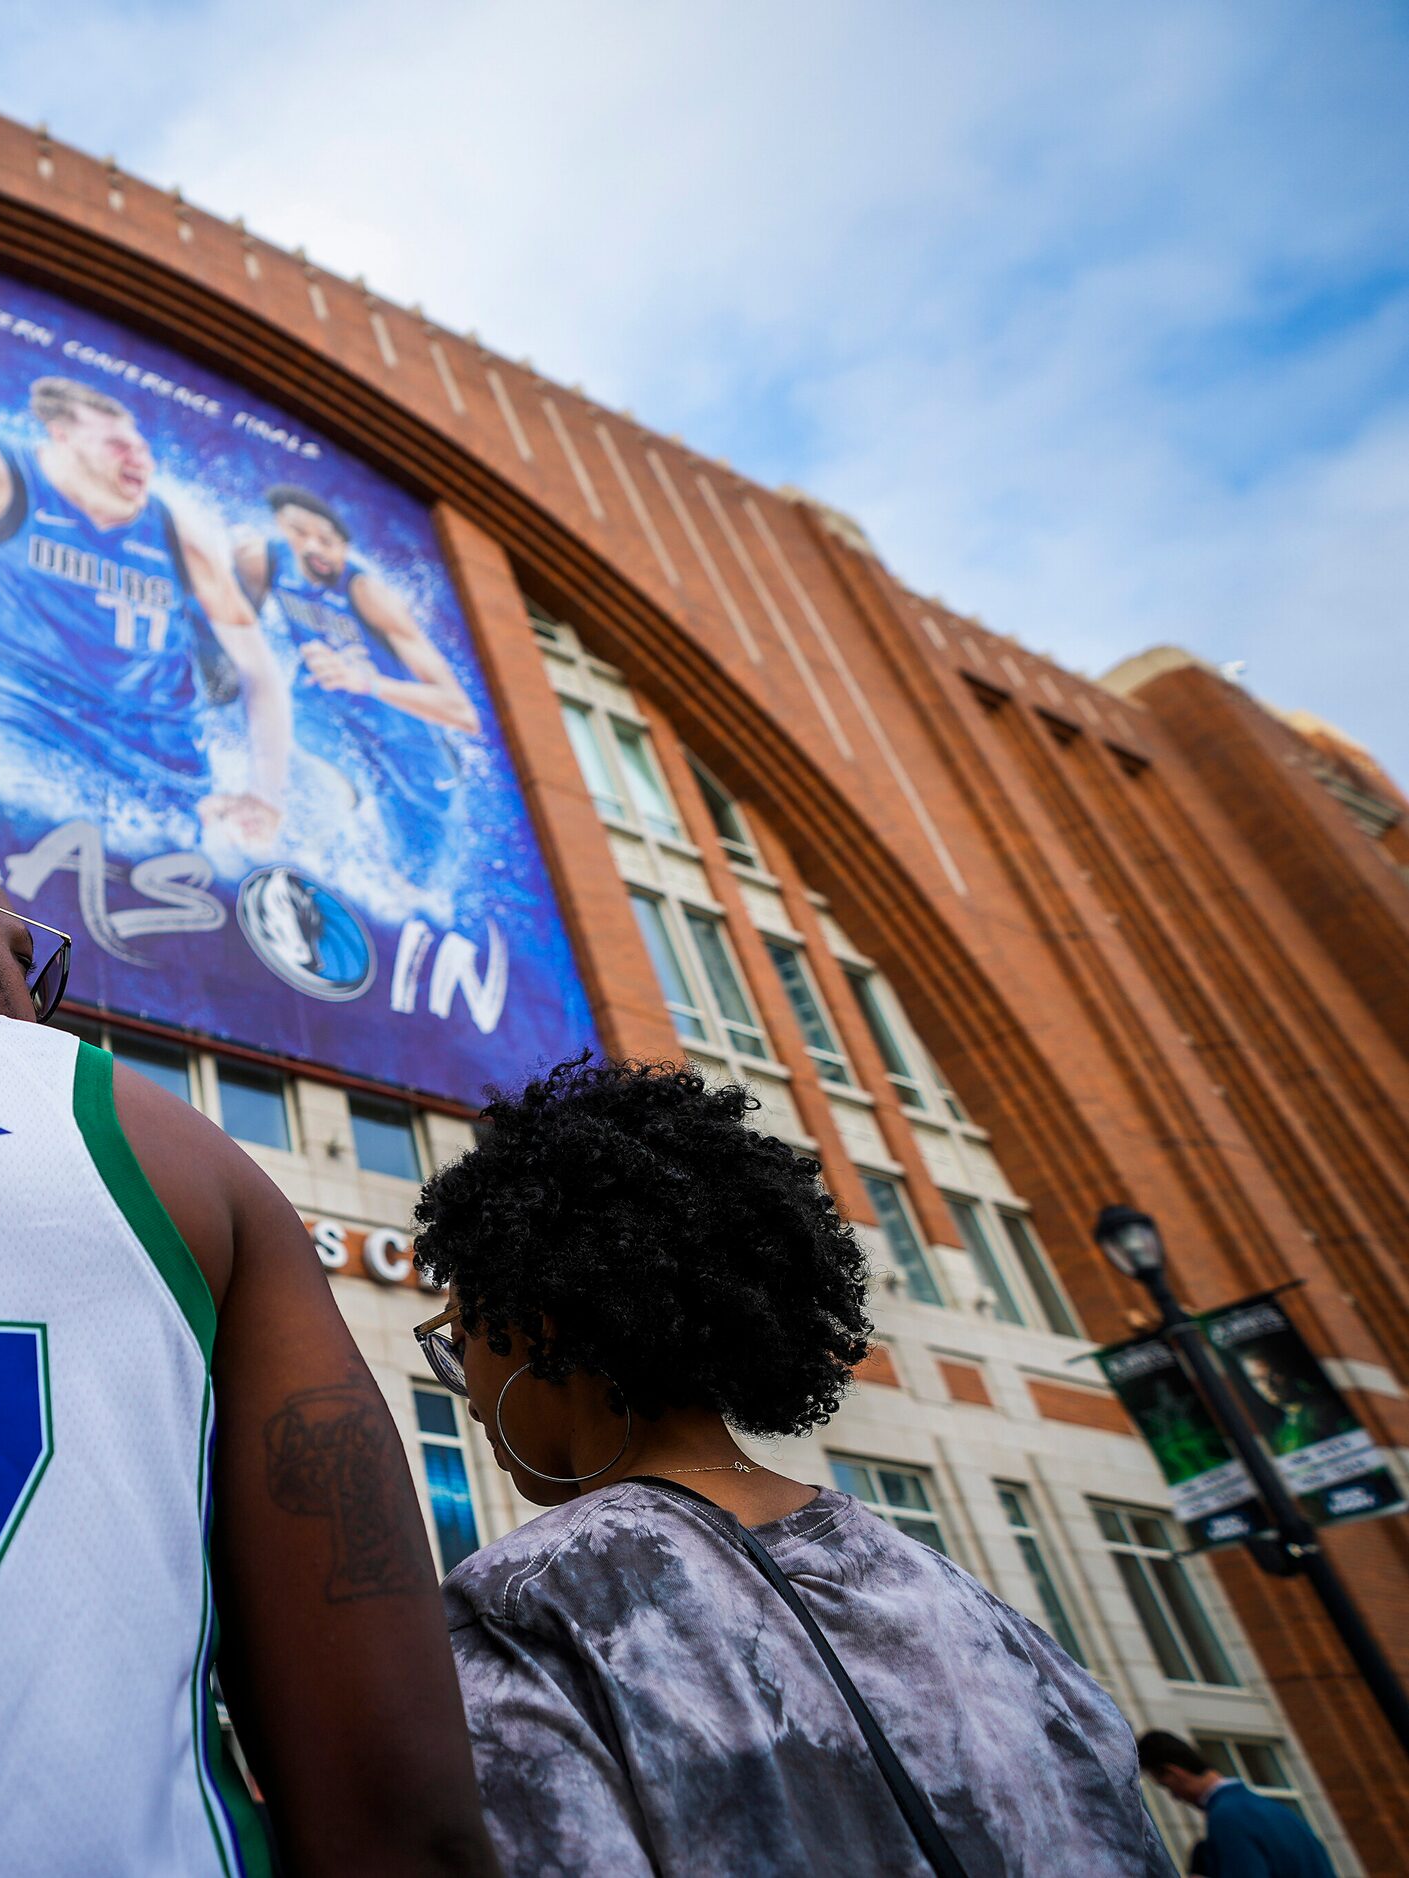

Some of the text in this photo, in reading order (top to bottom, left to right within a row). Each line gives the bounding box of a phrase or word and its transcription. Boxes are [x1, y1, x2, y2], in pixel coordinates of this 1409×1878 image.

[62, 340, 222, 418] CONFERENCE
[232, 411, 321, 461] FINALS
[95, 590, 169, 652] 77
[390, 915, 509, 1035] IN
